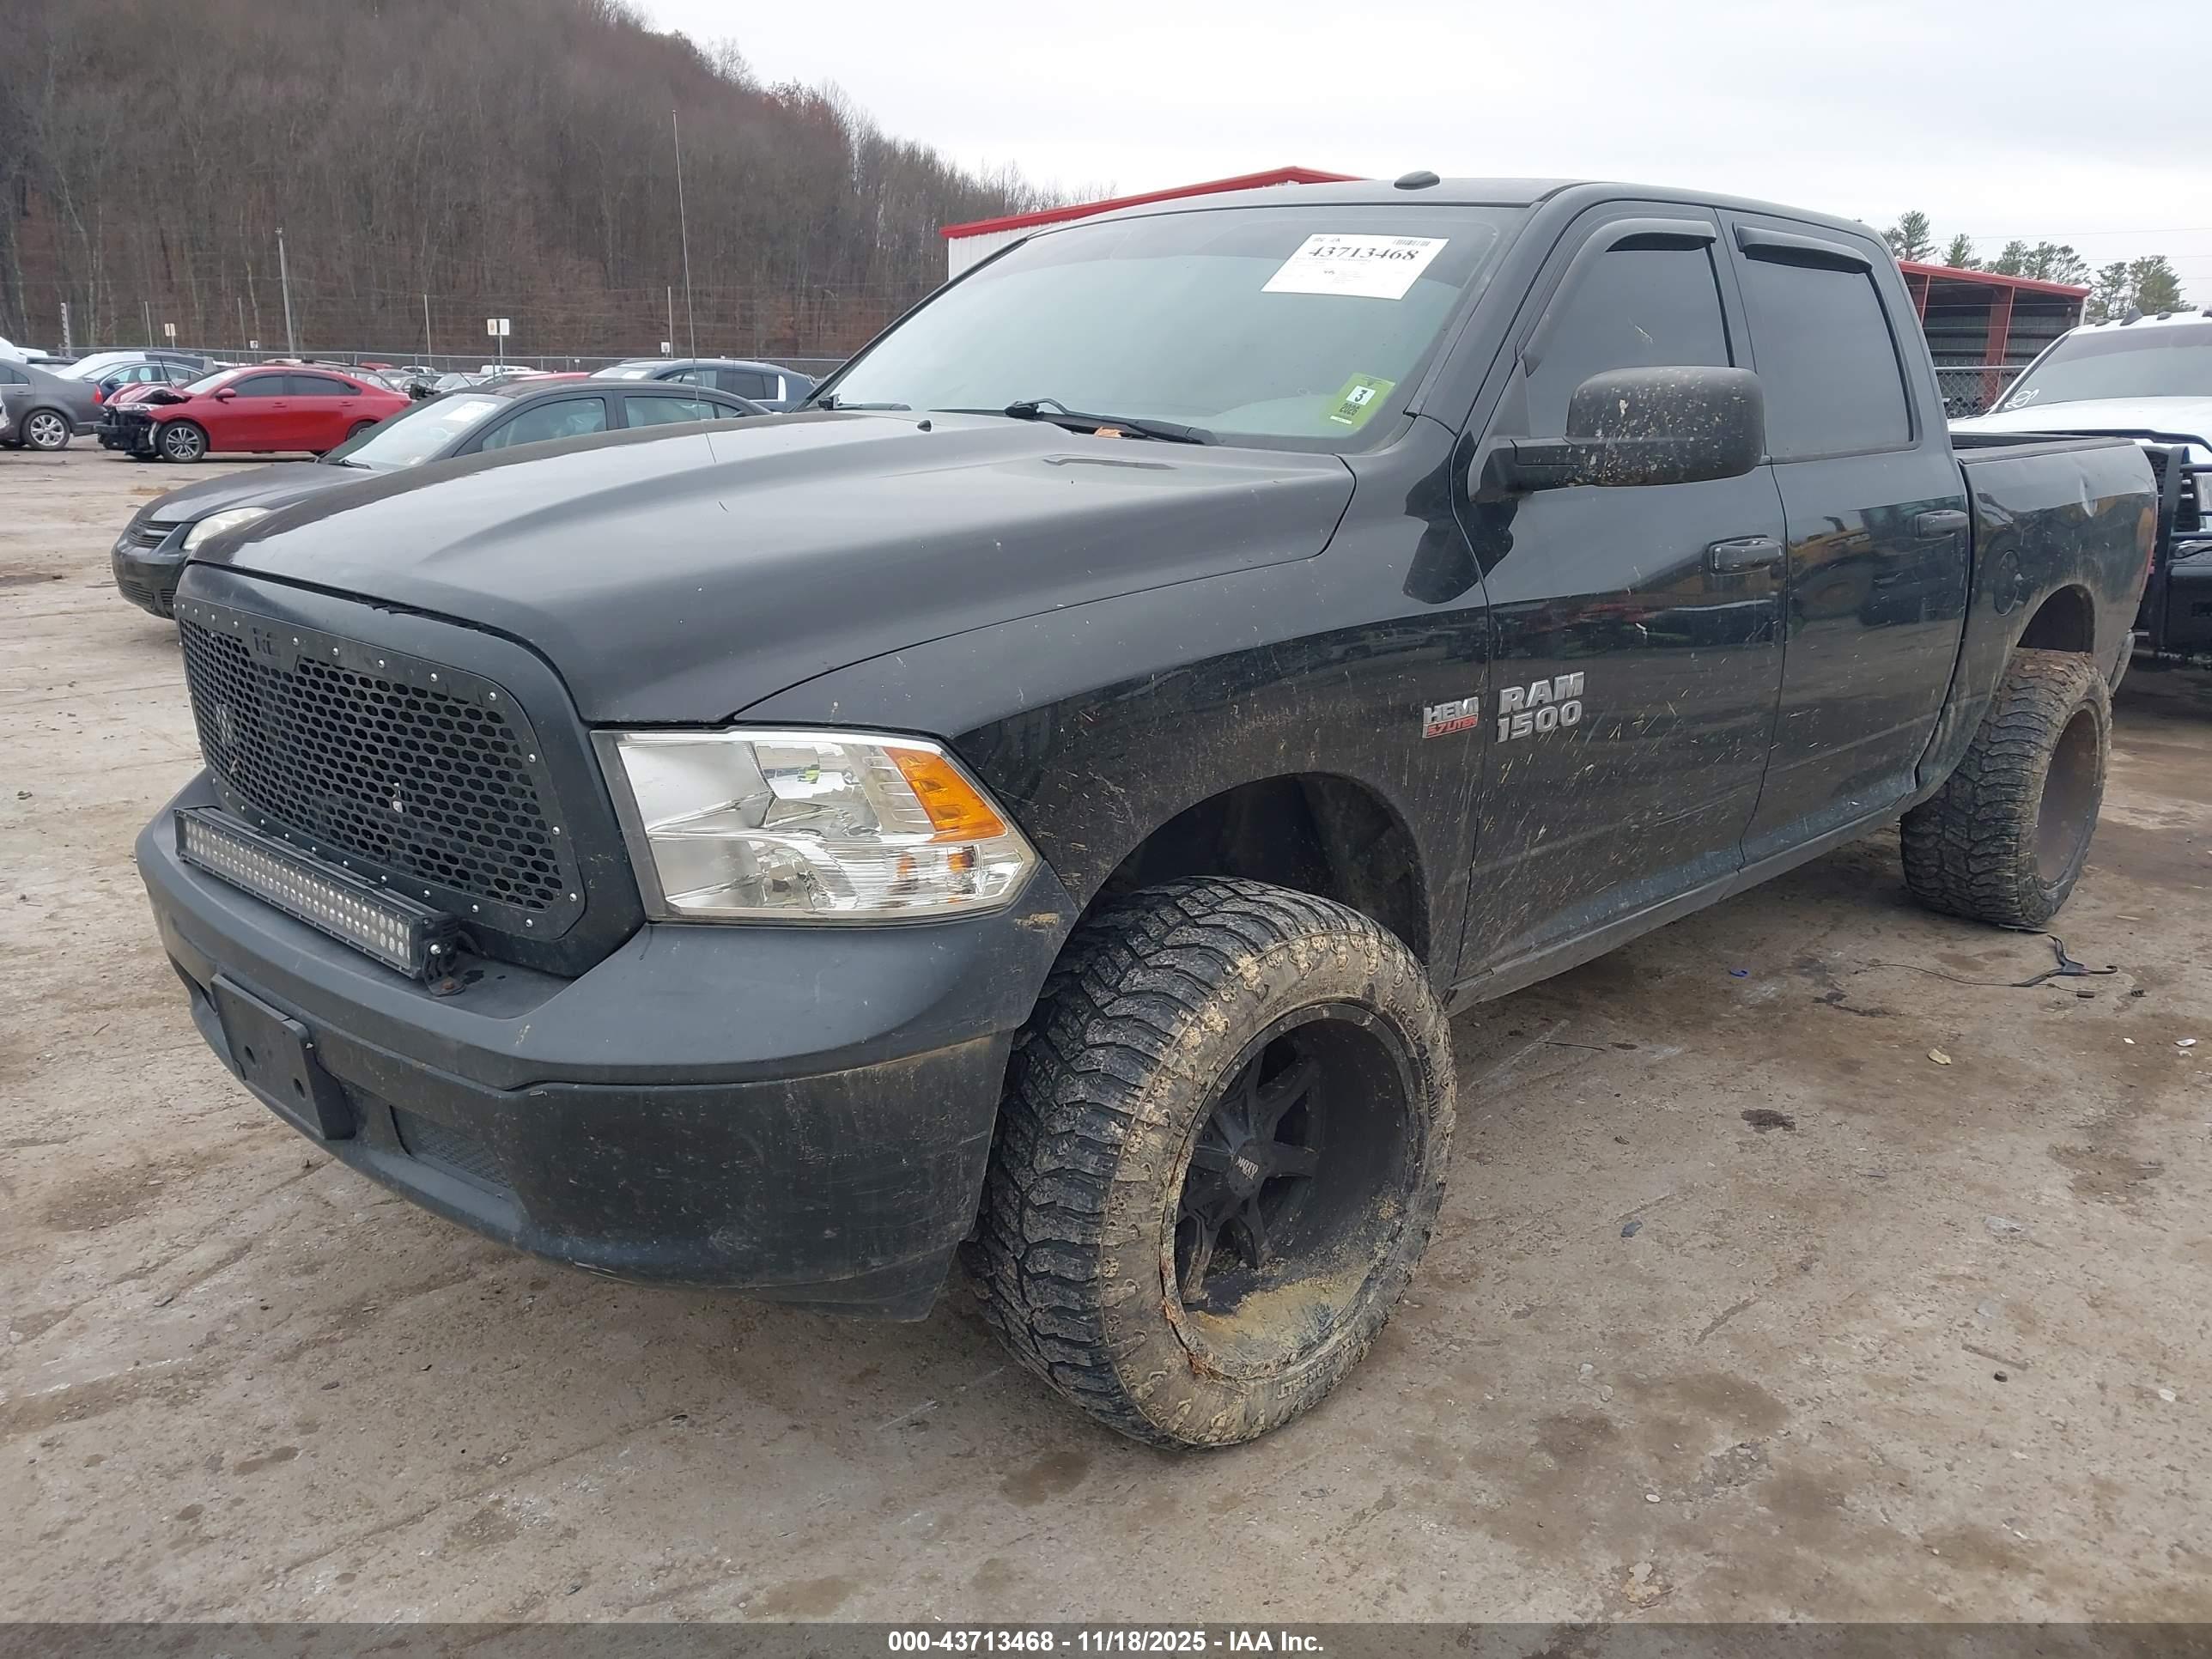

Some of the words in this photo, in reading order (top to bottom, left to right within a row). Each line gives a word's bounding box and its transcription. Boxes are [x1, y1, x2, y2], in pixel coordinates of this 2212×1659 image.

[1309, 246, 1419, 261] 43713468
[1354, 389, 1369, 403] 3
[1499, 672, 1584, 714] RAM
[1424, 696, 1479, 725] HEMI
[1497, 699, 1583, 744] 1500
